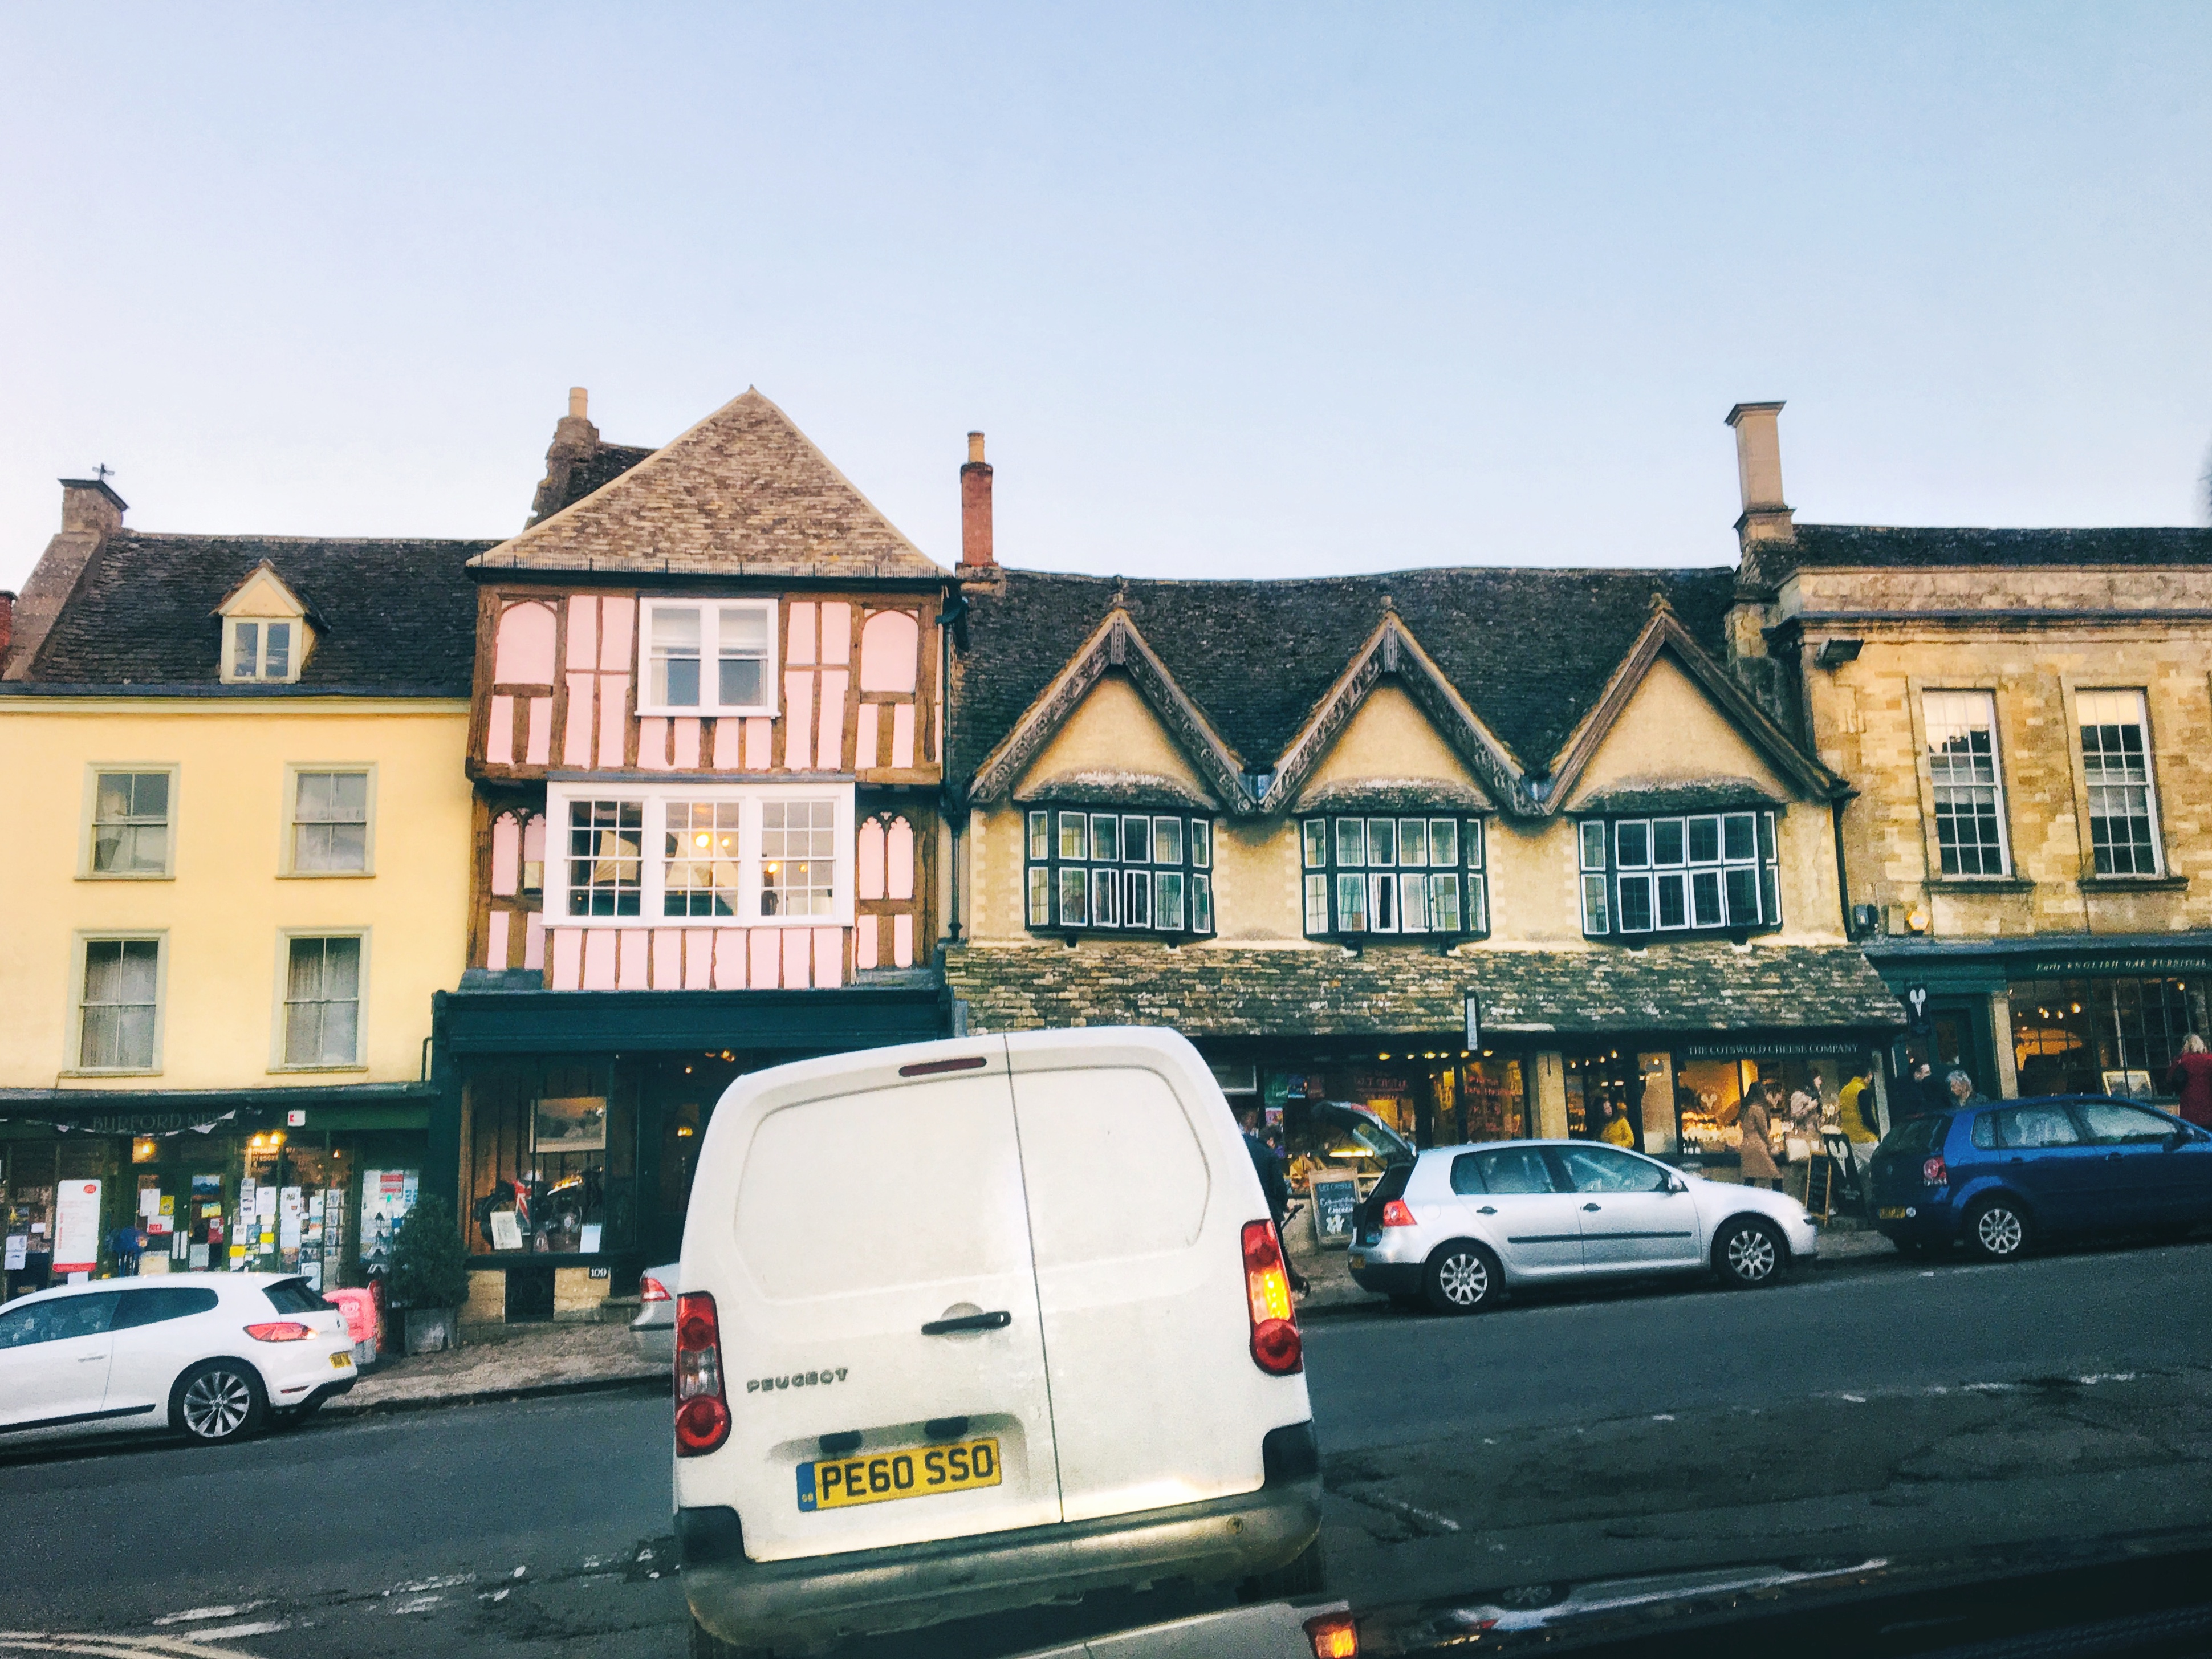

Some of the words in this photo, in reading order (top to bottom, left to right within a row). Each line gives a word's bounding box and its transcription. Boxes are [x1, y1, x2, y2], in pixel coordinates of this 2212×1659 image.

[1689, 1046, 1707, 1055] THE
[1710, 1044, 1766, 1055] COTSWOLD
[1768, 1044, 1807, 1054] CHEESE
[1809, 1043, 1859, 1054] COMPANY
[93, 1114, 182, 1132] BURFORD
[591, 1268, 607, 1277] 109
[746, 1367, 848, 1393] PEUGEOT
[821, 1455, 914, 1501] PE60
[924, 1444, 994, 1485] SSO
